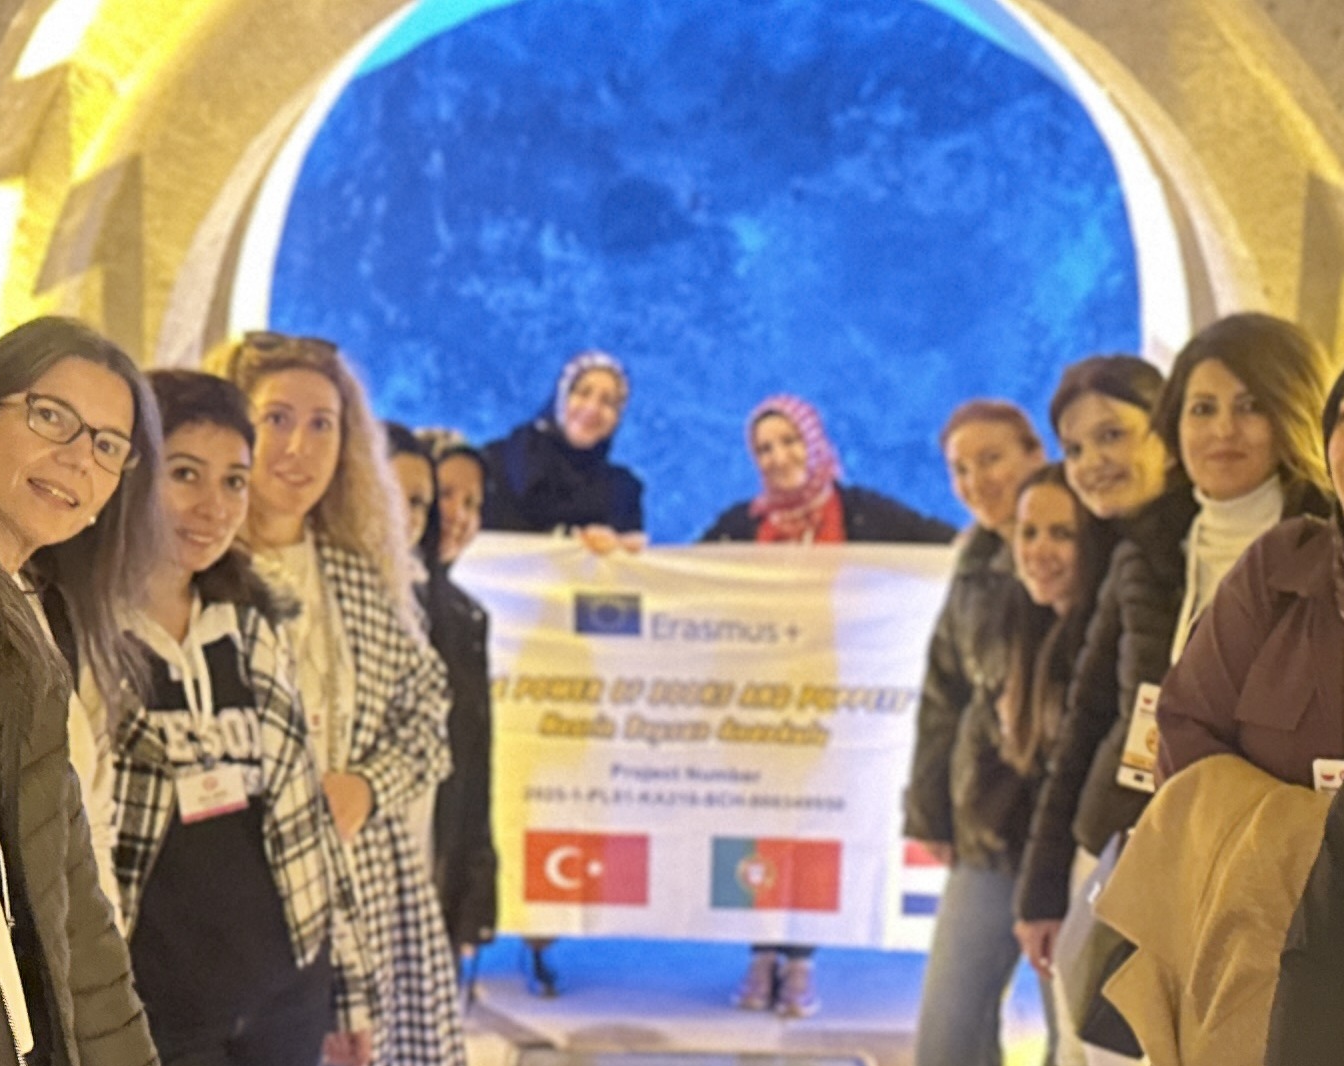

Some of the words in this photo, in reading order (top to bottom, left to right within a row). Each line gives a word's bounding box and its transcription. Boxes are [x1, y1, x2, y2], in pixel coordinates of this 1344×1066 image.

[651, 613, 779, 644] Erasmus
[611, 762, 679, 782] Project
[684, 765, 761, 784] Number
